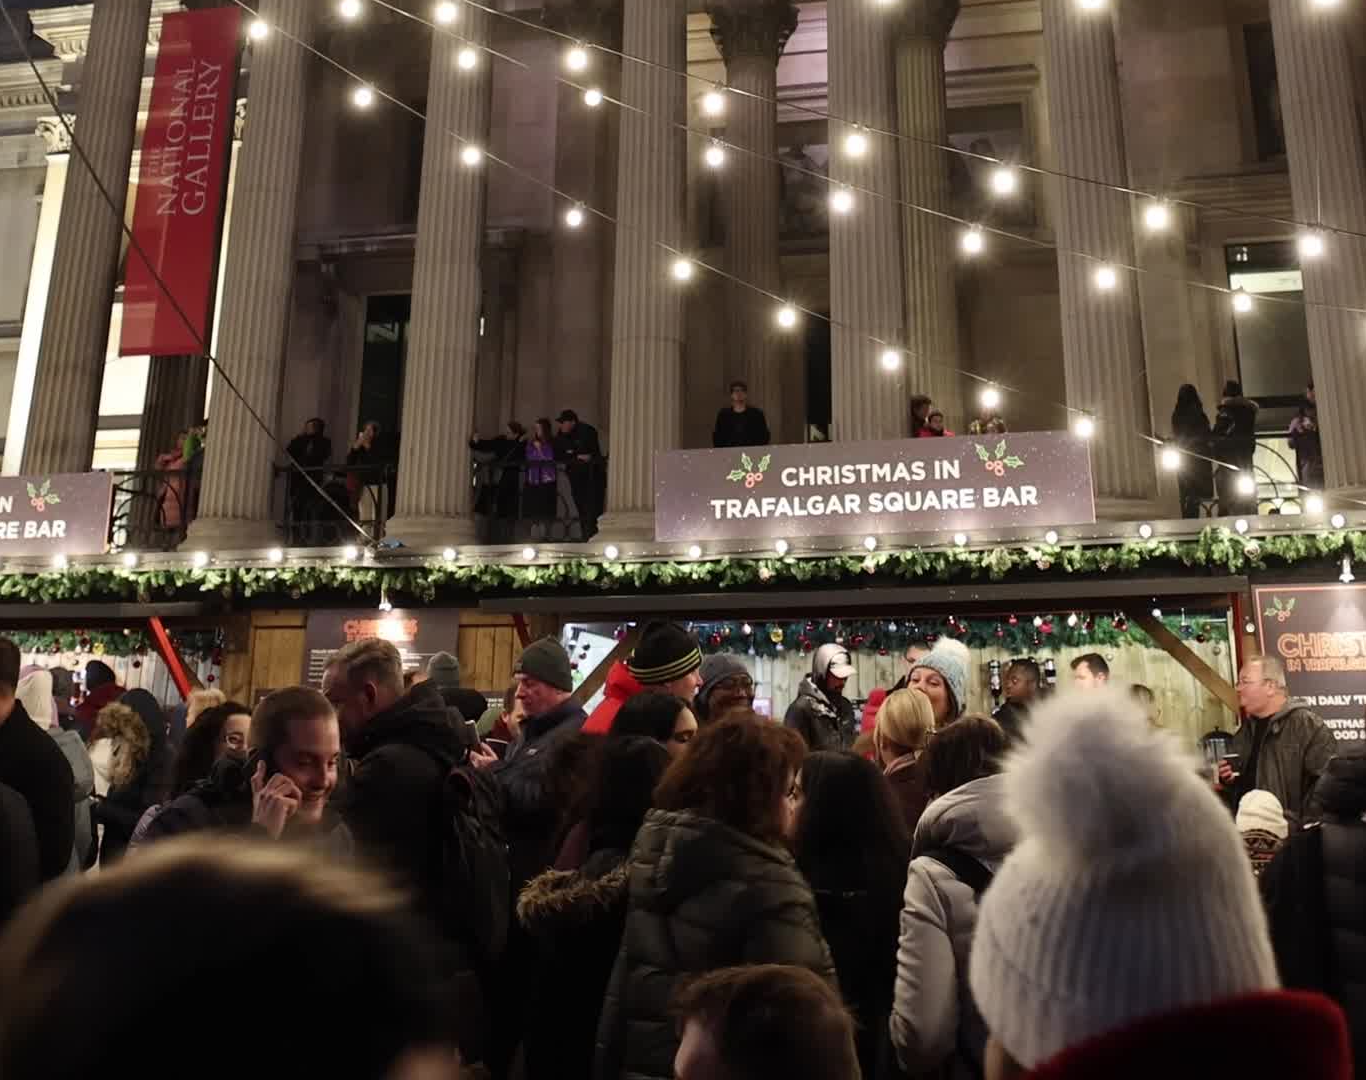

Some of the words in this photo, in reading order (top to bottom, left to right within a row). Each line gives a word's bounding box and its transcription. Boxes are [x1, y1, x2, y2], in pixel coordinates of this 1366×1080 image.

[156, 58, 197, 216] NATIONAL
[181, 59, 222, 216] GALLERY
[780, 461, 927, 488] CHRISTMAS
[934, 459, 961, 480] IN
[710, 492, 862, 520] TRAFALGAR
[868, 488, 976, 513] SQUARE
[982, 484, 1038, 507] BAR
[23, 519, 67, 539] BAR
[1318, 694, 1352, 706] DAILY
